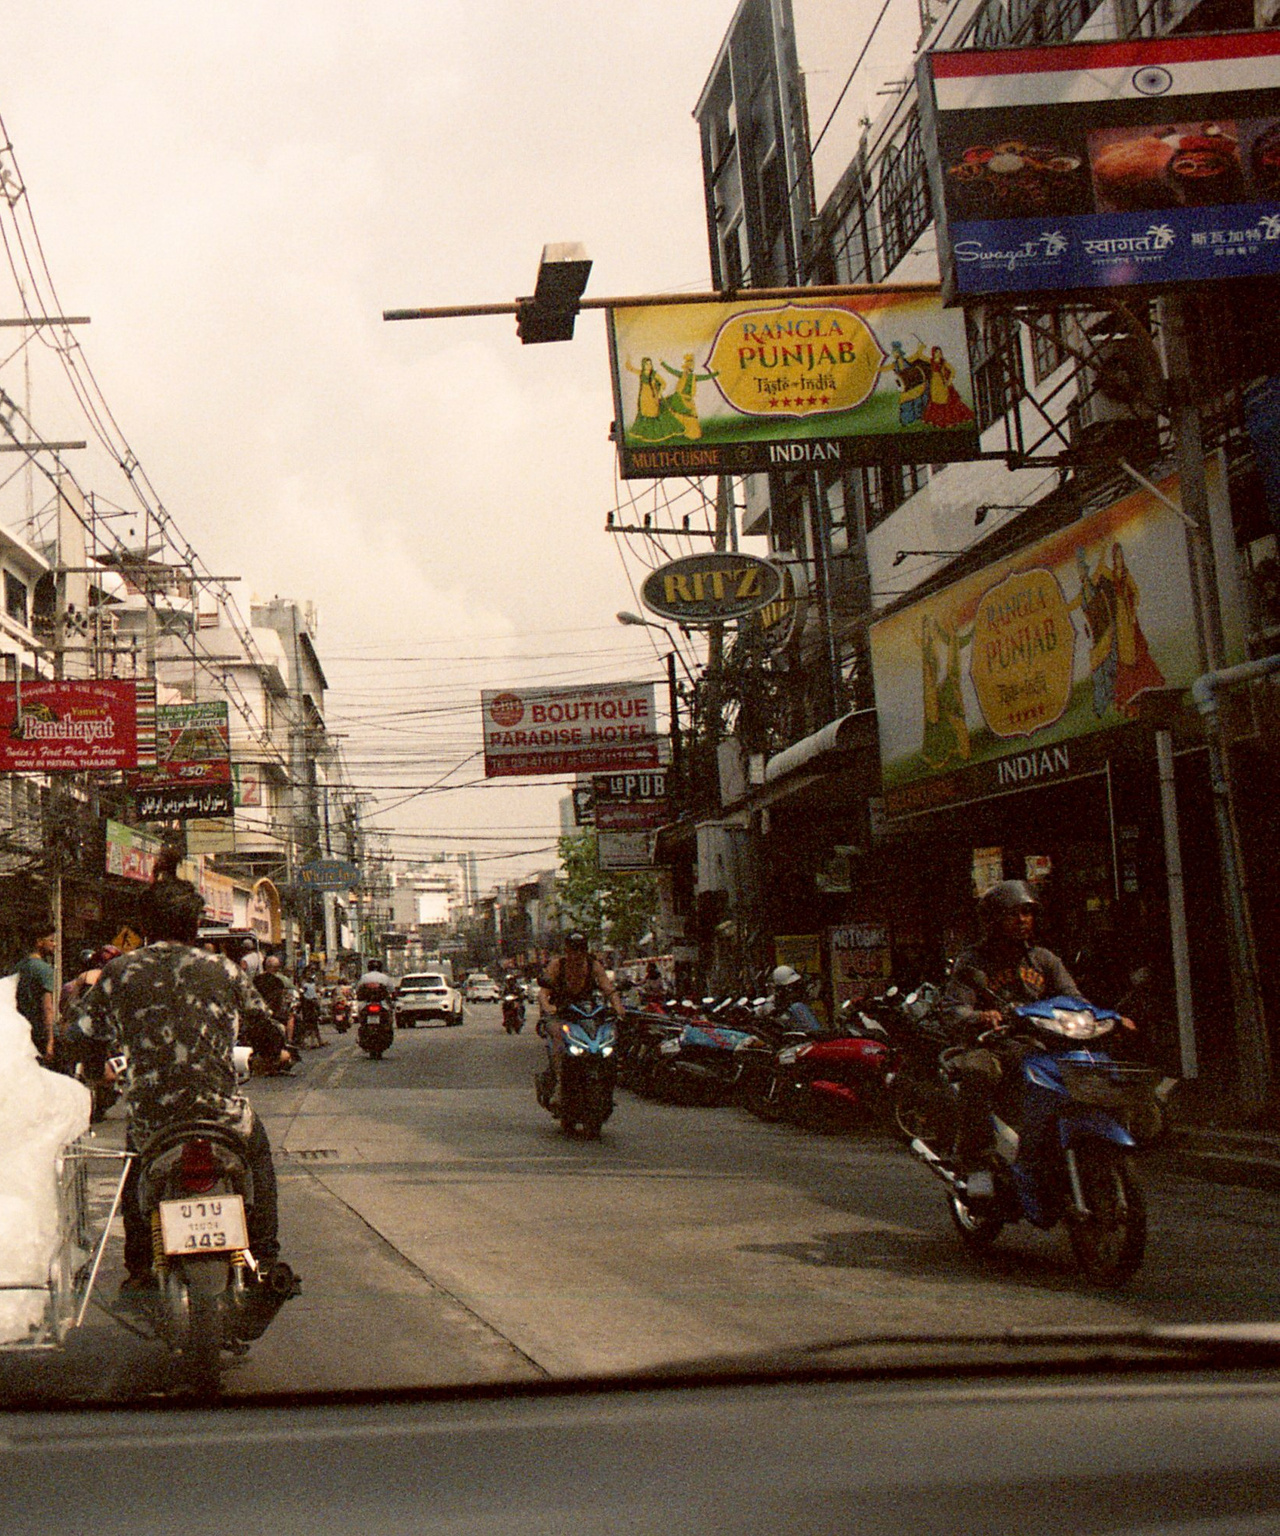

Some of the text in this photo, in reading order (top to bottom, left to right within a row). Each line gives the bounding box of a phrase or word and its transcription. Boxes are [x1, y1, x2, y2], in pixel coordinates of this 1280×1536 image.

[954, 241, 1040, 271] Swagat
[742, 319, 844, 344] RANGLA
[738, 341, 856, 371] PUNJAB
[753, 376, 789, 395] Taste
[800, 373, 837, 391] India
[769, 442, 841, 463] INDIAN
[663, 567, 762, 604] RITZ
[985, 617, 1058, 675] PUNJAB
[531, 698, 649, 723] BOUTIQUE
[22, 712, 115, 743] Panchayat
[489, 724, 648, 747] PARADISE HOTEL
[997, 746, 1070, 784] INDIAN
[625, 775, 665, 797] PUB
